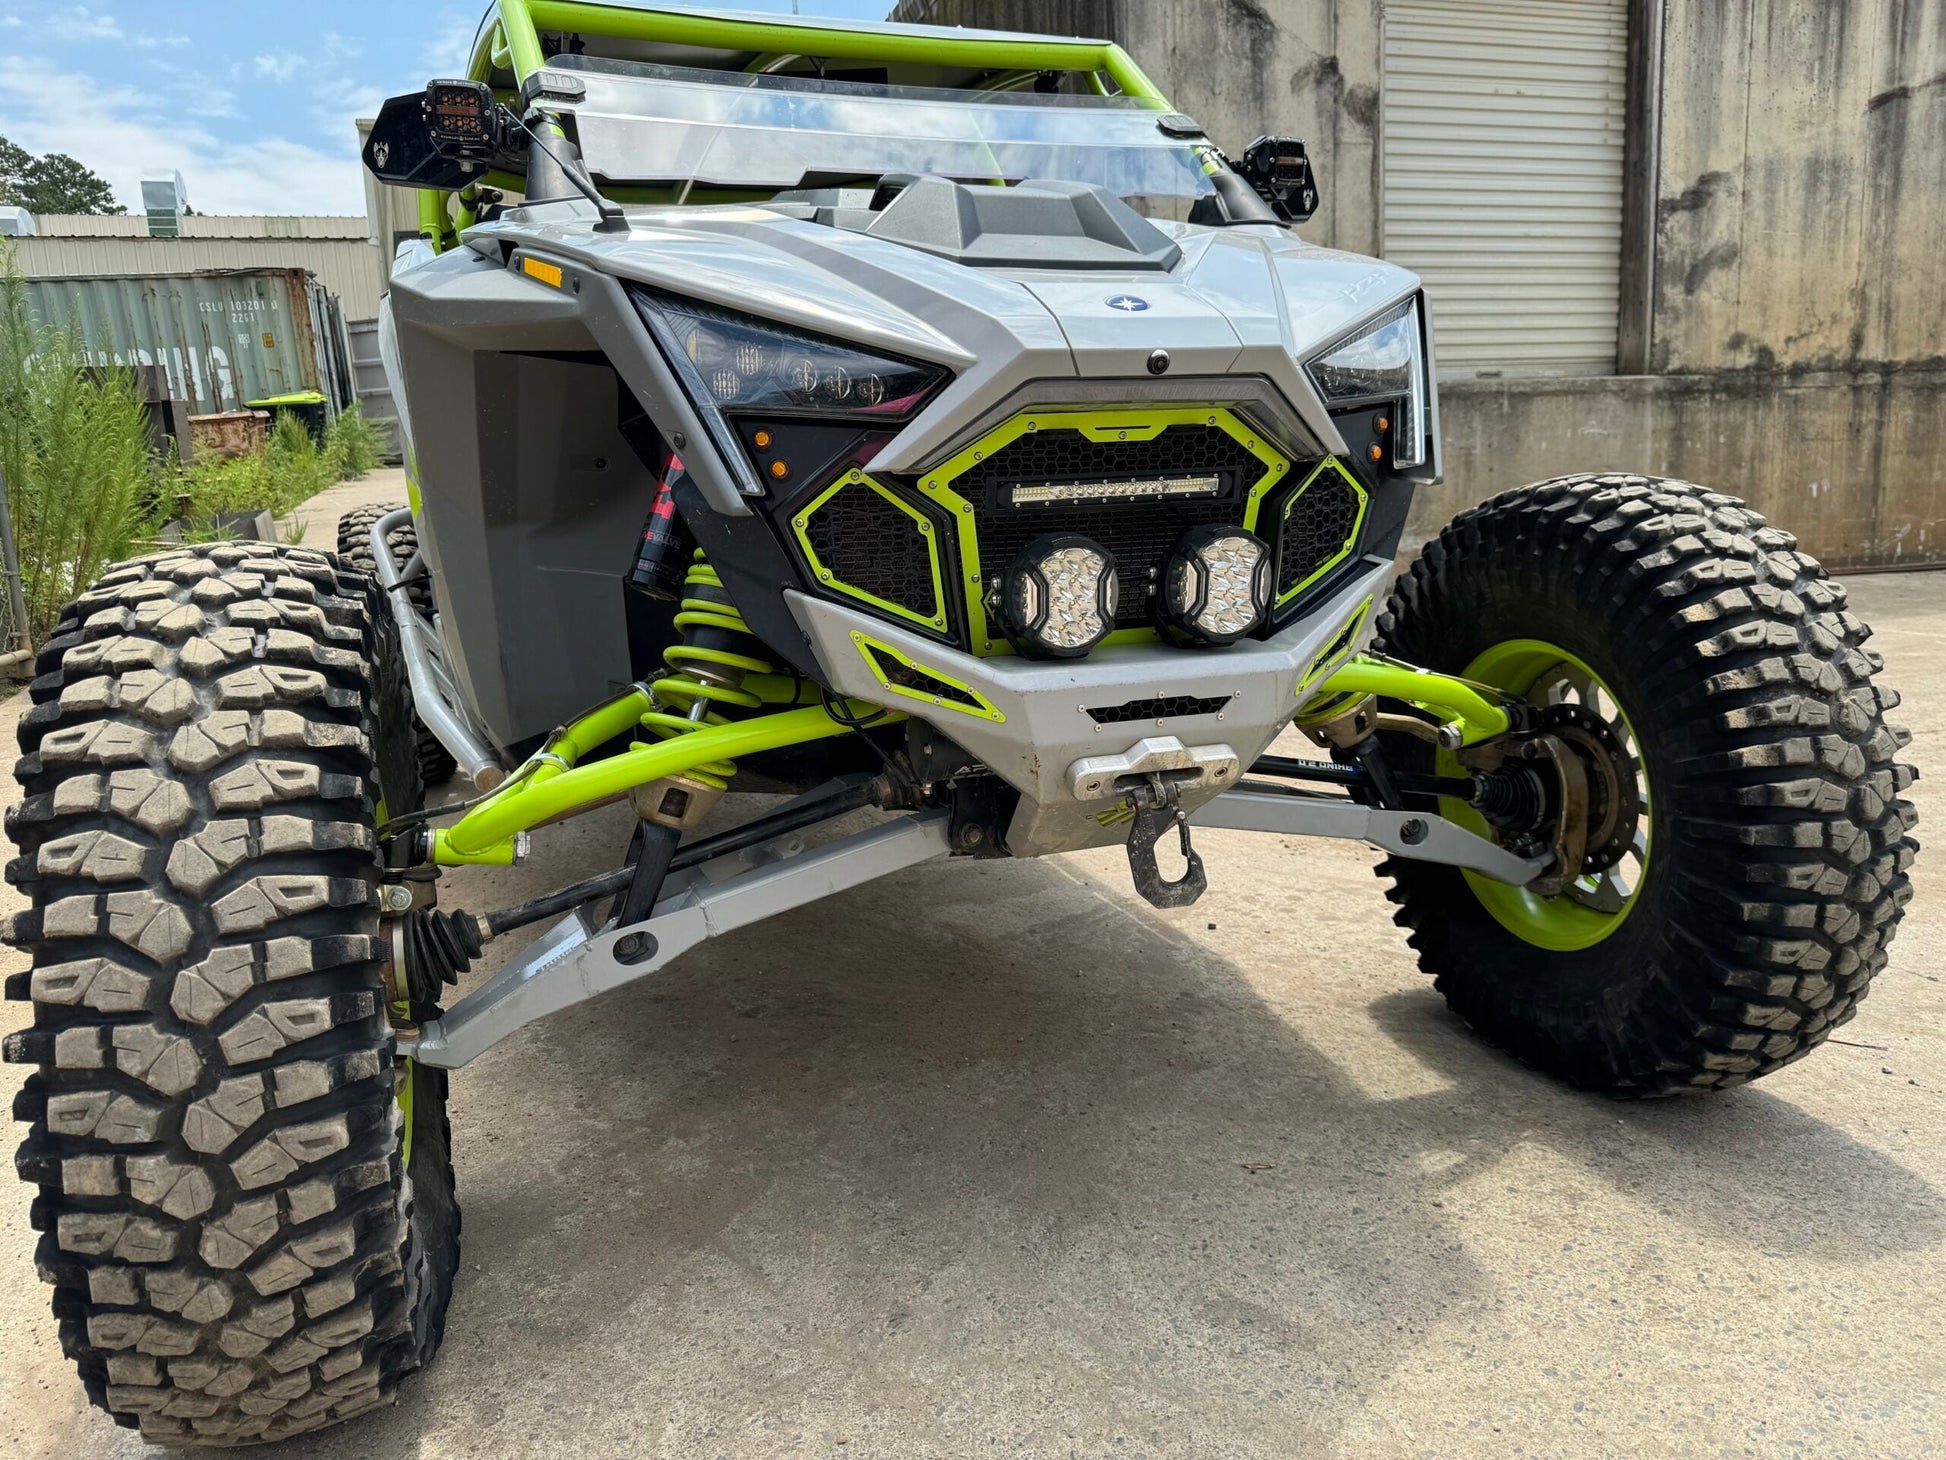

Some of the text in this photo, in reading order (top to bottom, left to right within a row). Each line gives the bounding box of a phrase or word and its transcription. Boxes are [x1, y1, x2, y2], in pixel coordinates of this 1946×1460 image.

[199, 301, 224, 312] CSLU
[230, 300, 265, 311] 103201
[1320, 762, 1353, 771] RHINO
